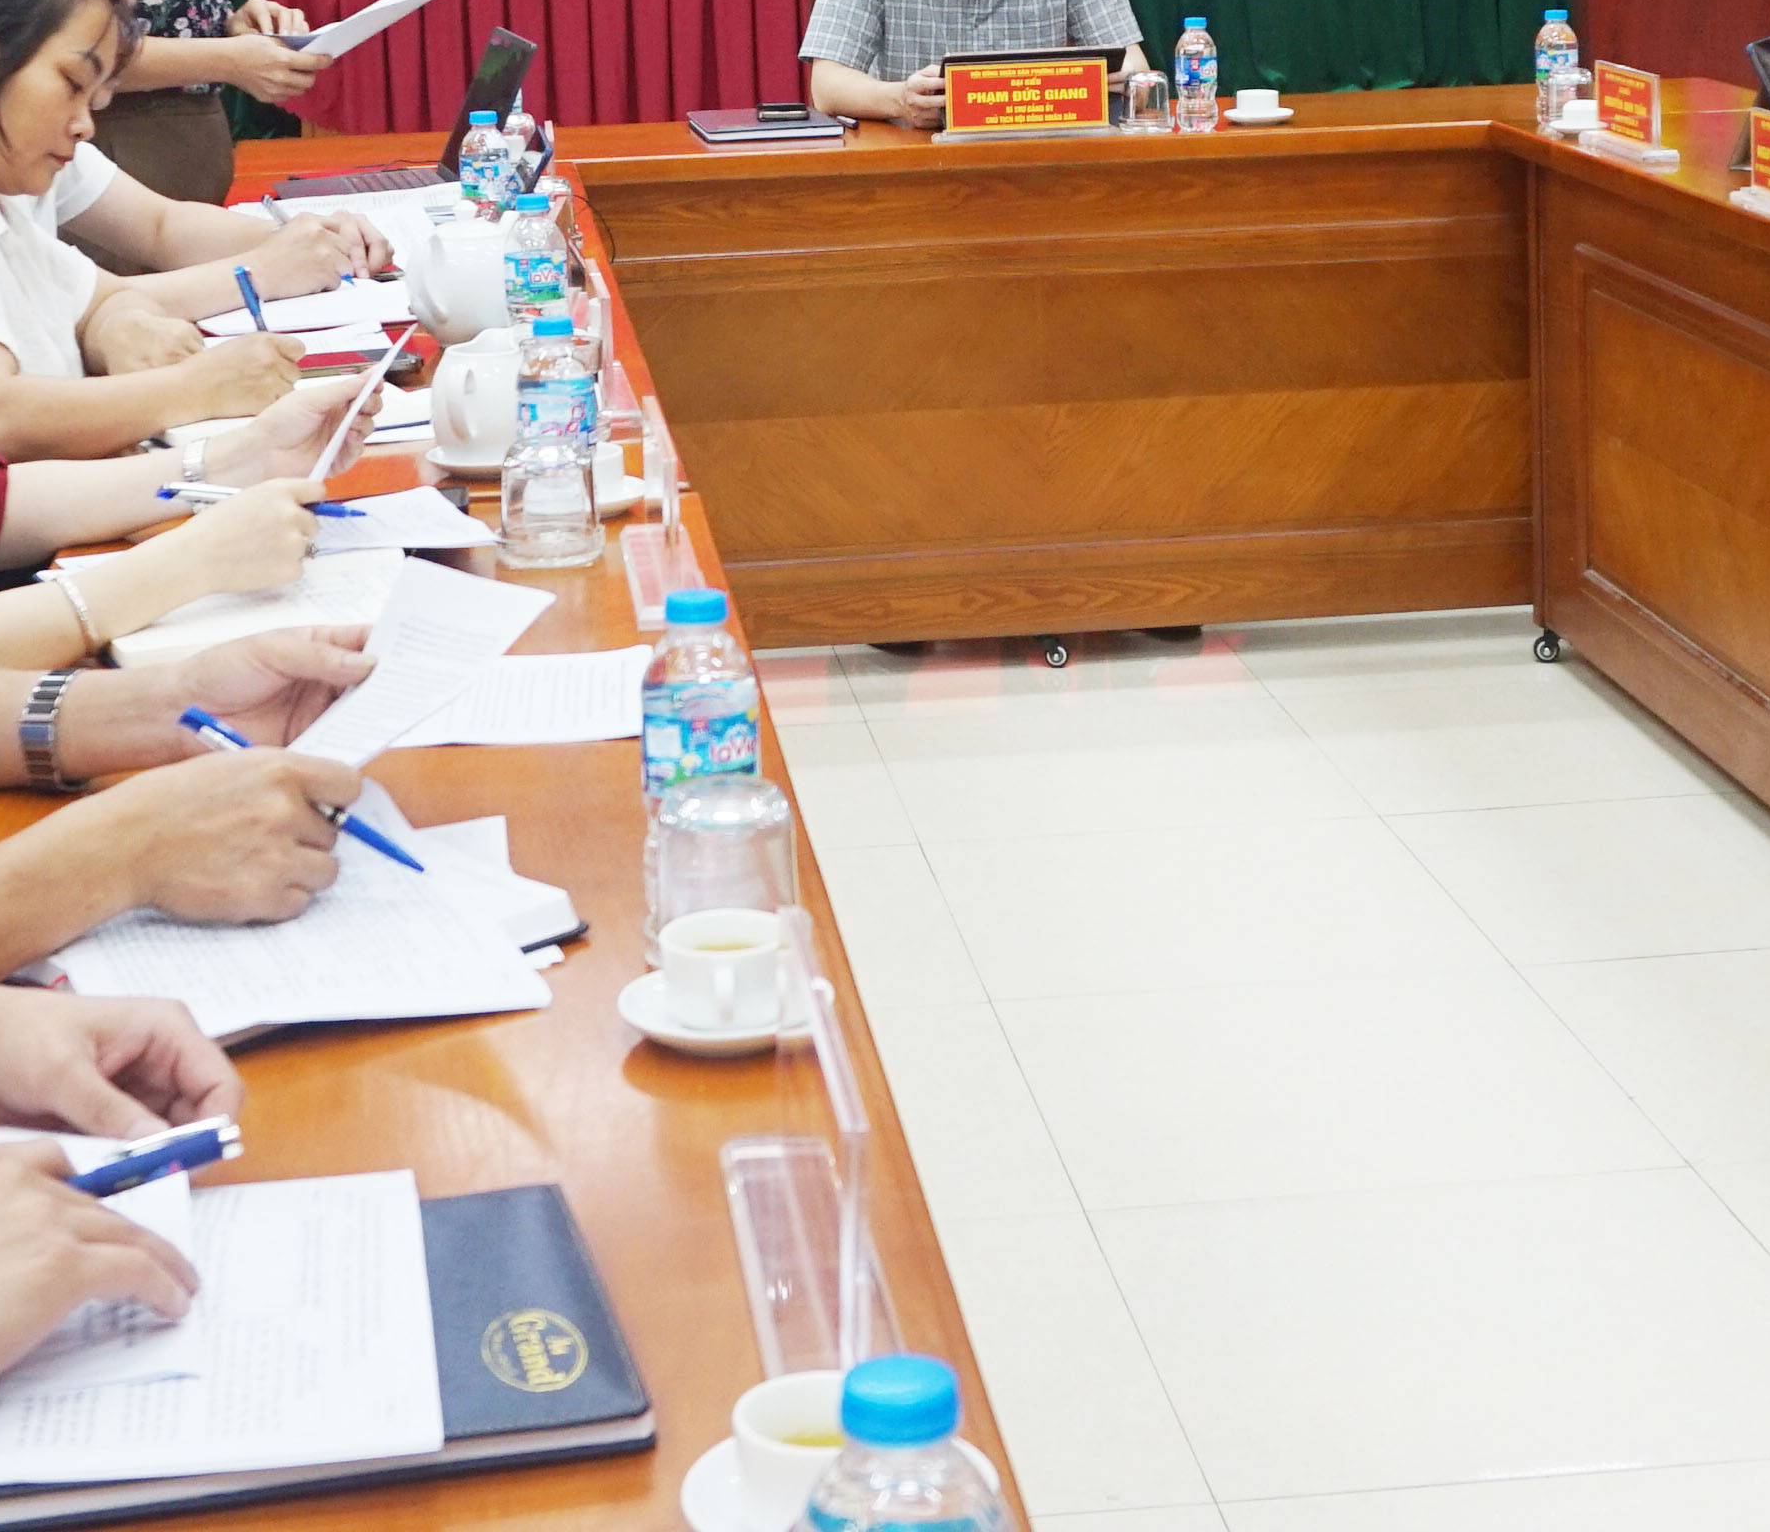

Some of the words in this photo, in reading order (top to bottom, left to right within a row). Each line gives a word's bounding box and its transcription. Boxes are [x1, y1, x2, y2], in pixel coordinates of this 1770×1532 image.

[967, 91, 1008, 105] PHẠM
[1012, 87, 1040, 102] ĐỨC
[1045, 87, 1088, 100] GIANG
